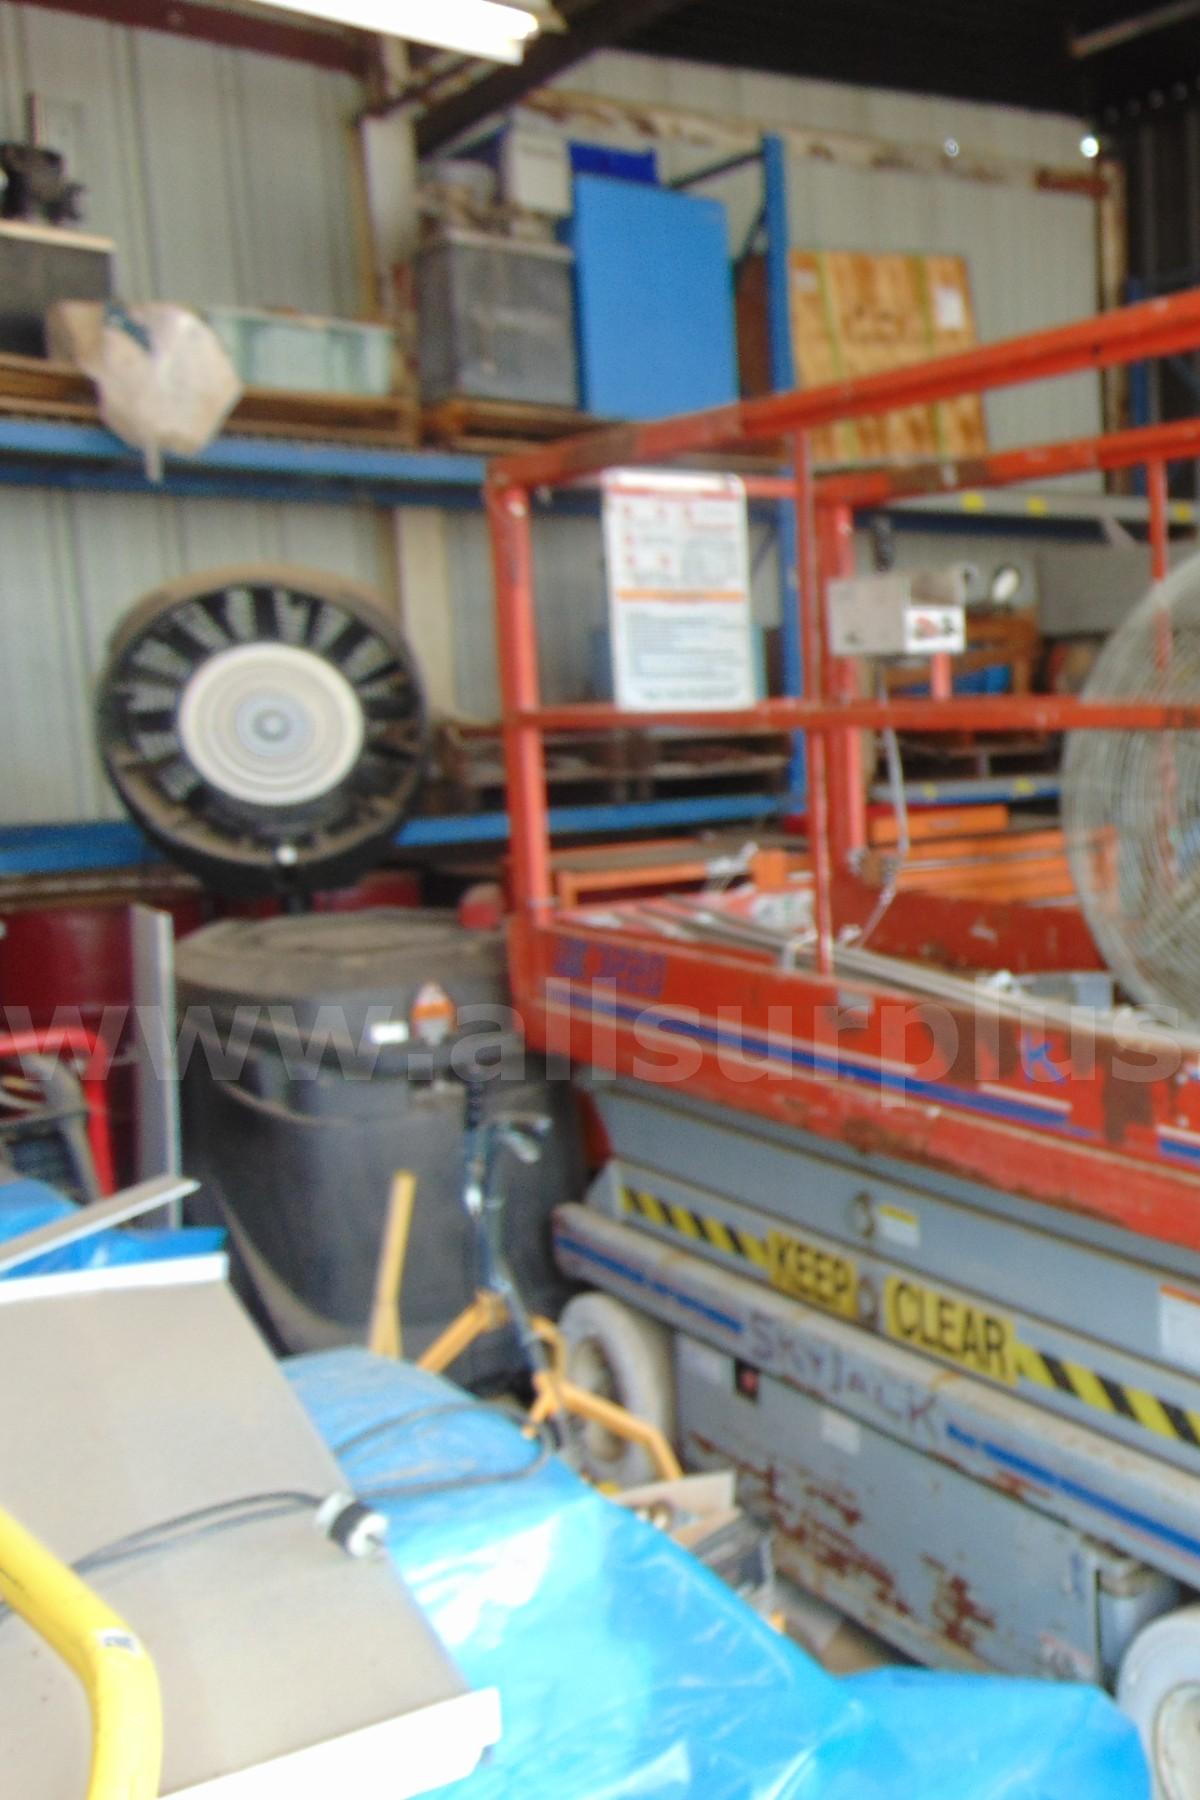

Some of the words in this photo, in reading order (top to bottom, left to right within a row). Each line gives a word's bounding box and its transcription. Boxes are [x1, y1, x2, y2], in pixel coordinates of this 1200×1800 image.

[772, 1235, 851, 1307] KEEP
[895, 1281, 1009, 1376] CLEAR
[750, 1308, 942, 1441] SKYJACK
